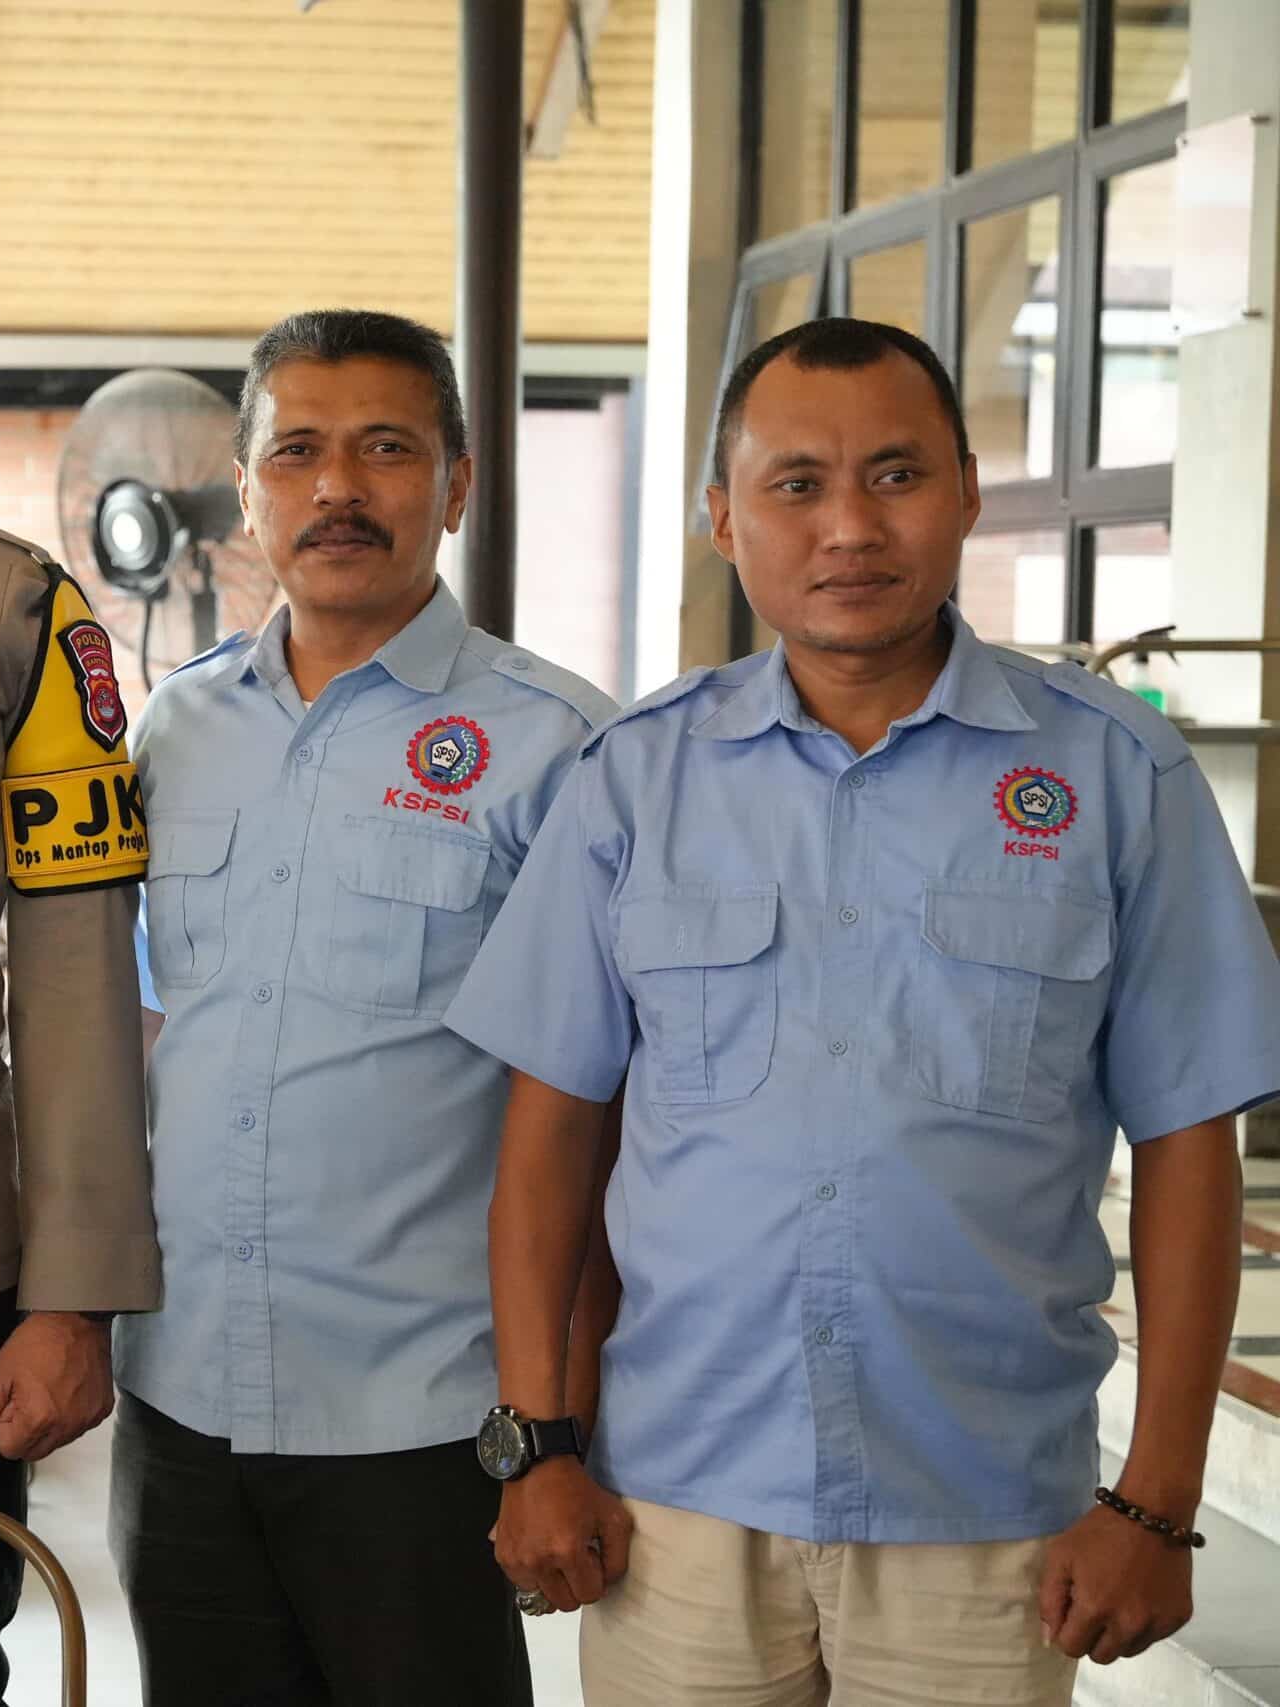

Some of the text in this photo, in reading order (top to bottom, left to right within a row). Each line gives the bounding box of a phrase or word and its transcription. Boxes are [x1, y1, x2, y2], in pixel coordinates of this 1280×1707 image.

[76, 633, 106, 648] POLDA
[433, 745, 457, 762] SPSI
[383, 787, 470, 824] KSPSI
[1023, 791, 1048, 809] SPSI
[16, 848, 41, 869] Ops
[52, 840, 110, 859] Mantap
[1004, 840, 1059, 861] KSPSI
